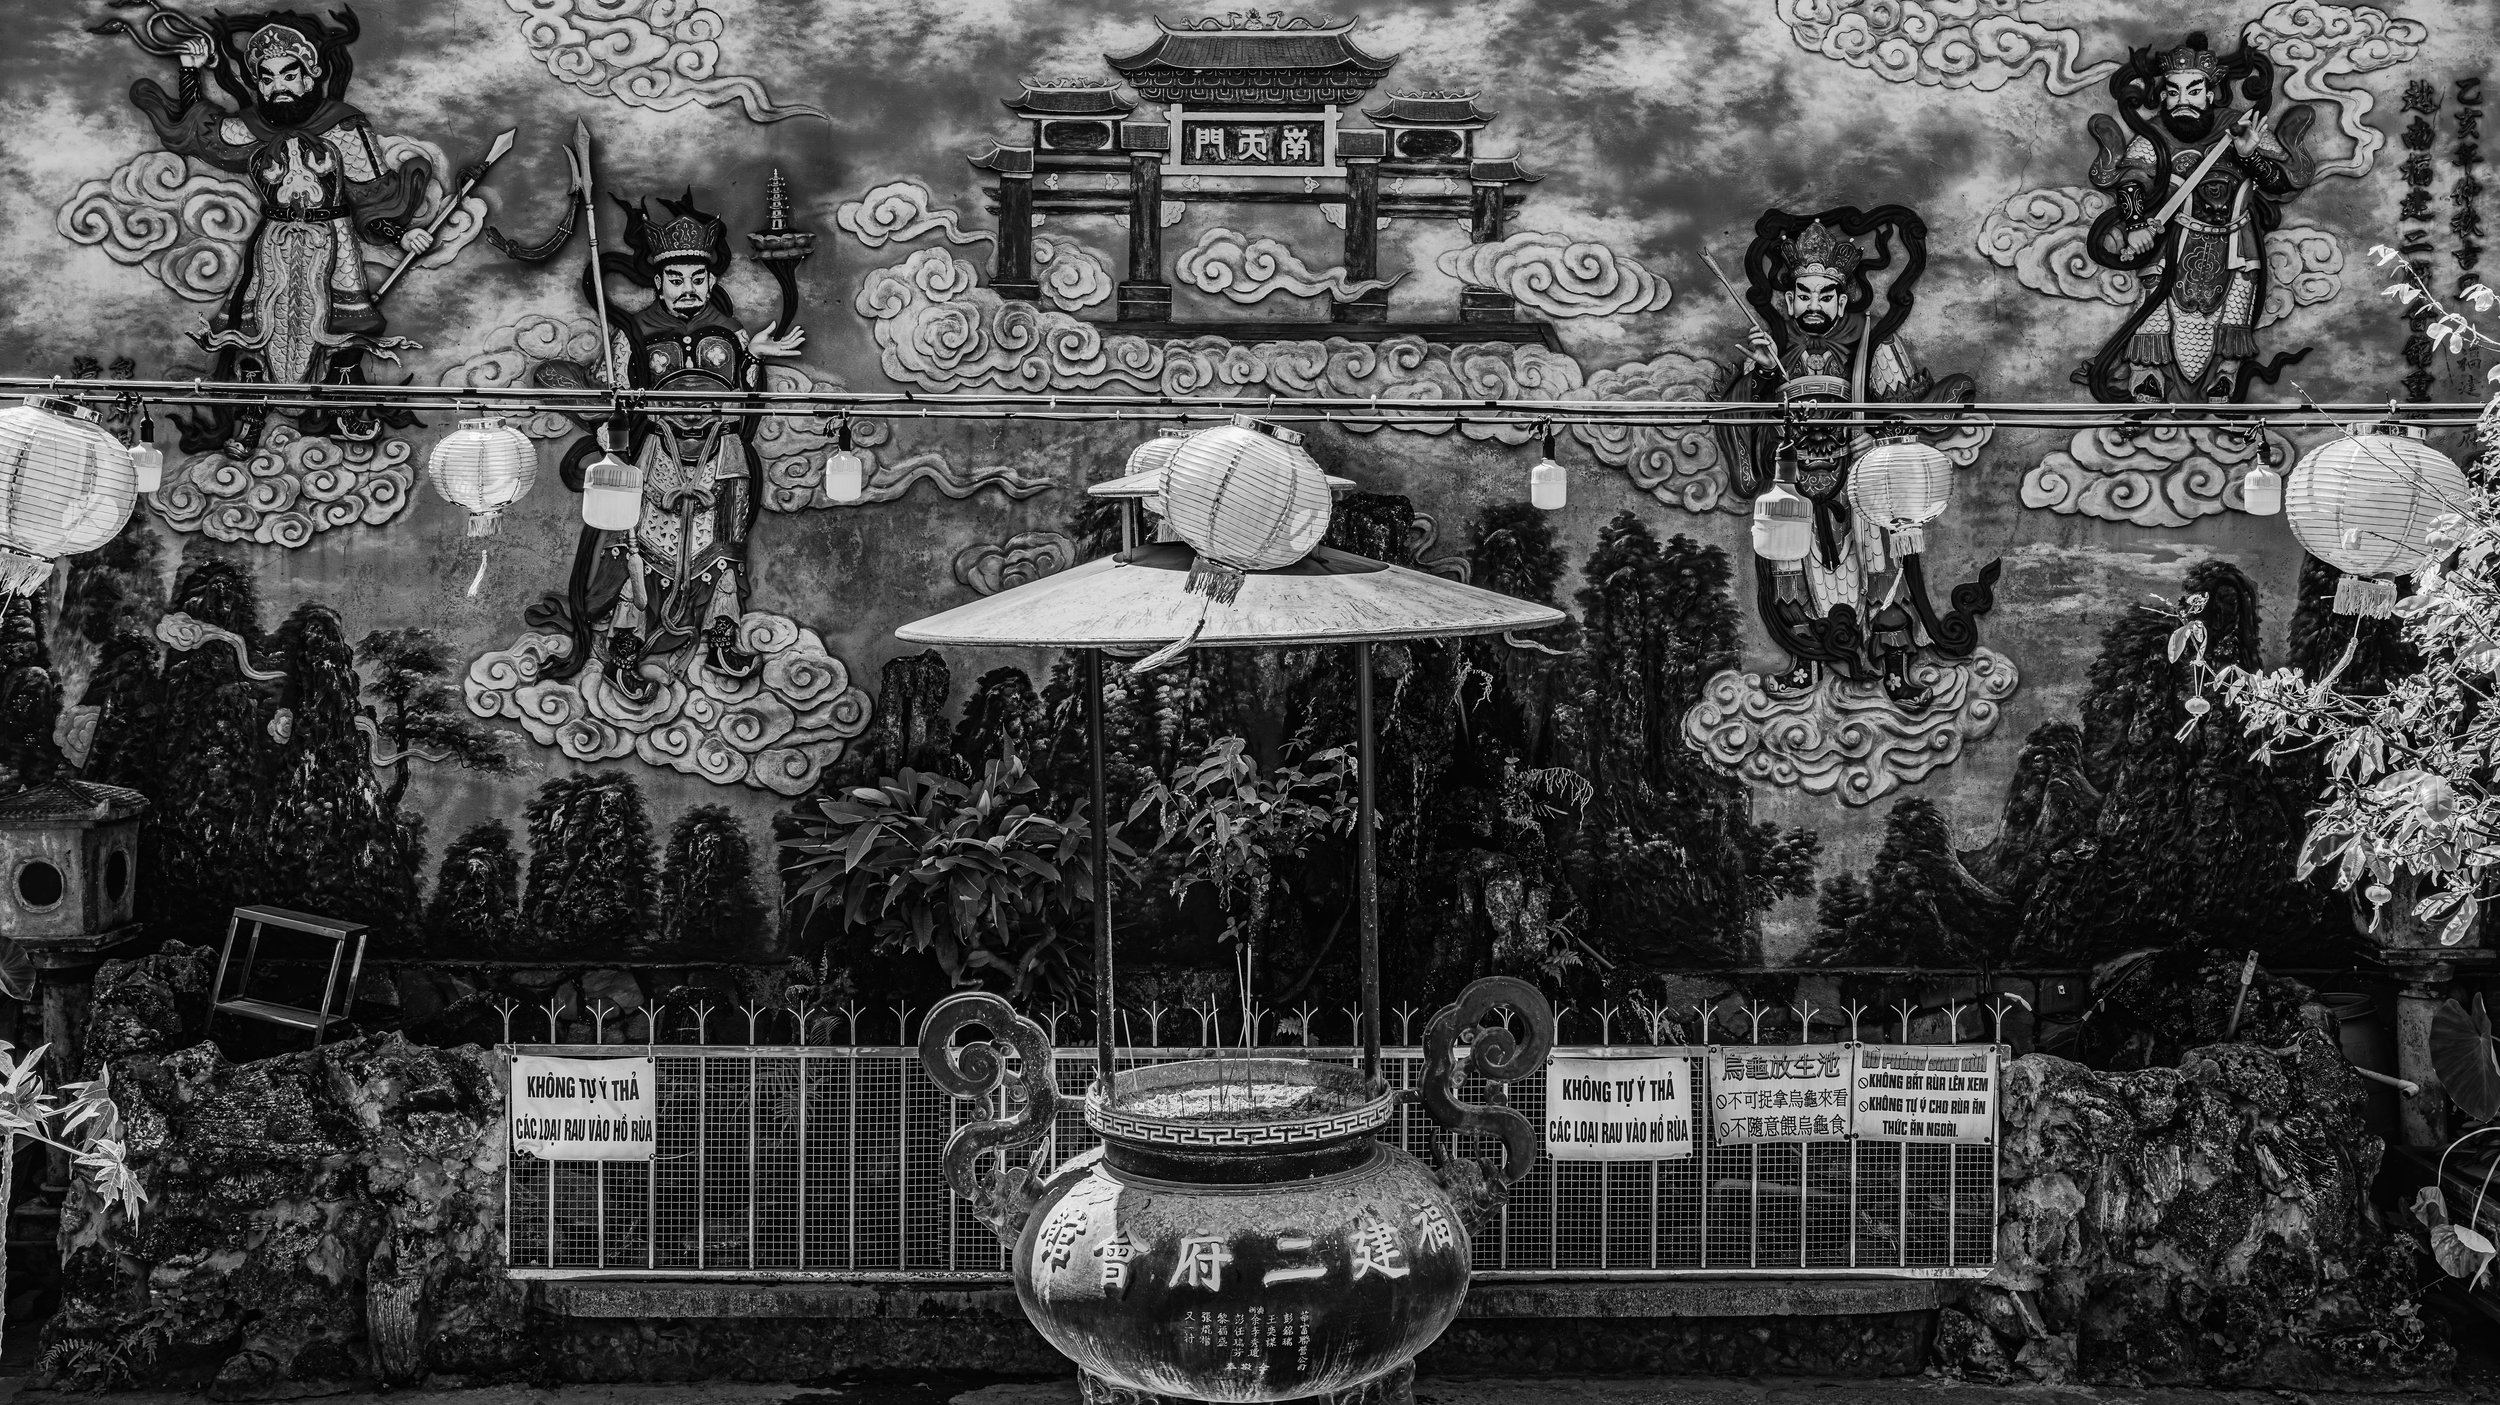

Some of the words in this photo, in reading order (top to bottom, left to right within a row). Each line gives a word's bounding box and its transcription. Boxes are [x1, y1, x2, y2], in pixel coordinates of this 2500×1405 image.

[1722, 1051, 1840, 1081] 烏龜放生池
[527, 1072, 575, 1099] KHÔNG
[579, 1077, 597, 1103] TỰ
[598, 1076, 607, 1100] Ý
[611, 1071, 640, 1101] THẢ
[1562, 1075, 1611, 1103] KHÔNG
[1616, 1078, 1634, 1107] TỰ
[1637, 1076, 1645, 1102] Ý
[1650, 1071, 1675, 1102] THẢ
[1869, 1072, 1903, 1089] KHÔNG
[1905, 1071, 1924, 1090] BẮT
[1926, 1074, 1945, 1091] RÙA
[1948, 1075, 1964, 1091] LÊN
[1967, 1077, 1988, 1092] XEM
[1728, 1088, 1848, 1110] 不可捉拿烏龜來看
[1869, 1095, 1903, 1112] KHÔNG
[1905, 1097, 1918, 1116] TỰ
[1919, 1097, 1926, 1112] Ý
[1929, 1100, 1948, 1114] CHO
[1951, 1097, 1970, 1114] RÙA
[1972, 1097, 1986, 1114] ĂN
[516, 1113, 537, 1140] CÁC
[539, 1118, 561, 1146] LOẠI
[564, 1118, 586, 1141] RAU
[588, 1115, 610, 1142] VÀO
[613, 1113, 628, 1142] HỒ
[631, 1115, 653, 1142] RÙA
[1549, 1116, 1571, 1143] CÁC
[1574, 1120, 1598, 1147] LOẠI
[1602, 1122, 1622, 1143] RAU
[1626, 1117, 1647, 1143] VÀO
[1650, 1114, 1664, 1143] HỒ
[1666, 1115, 1689, 1142] RÙA
[1730, 1113, 1846, 1138] 不隨意餵烏龜食
[1882, 1119, 1908, 1136] THỨC
[1910, 1119, 1924, 1136] ĂN
